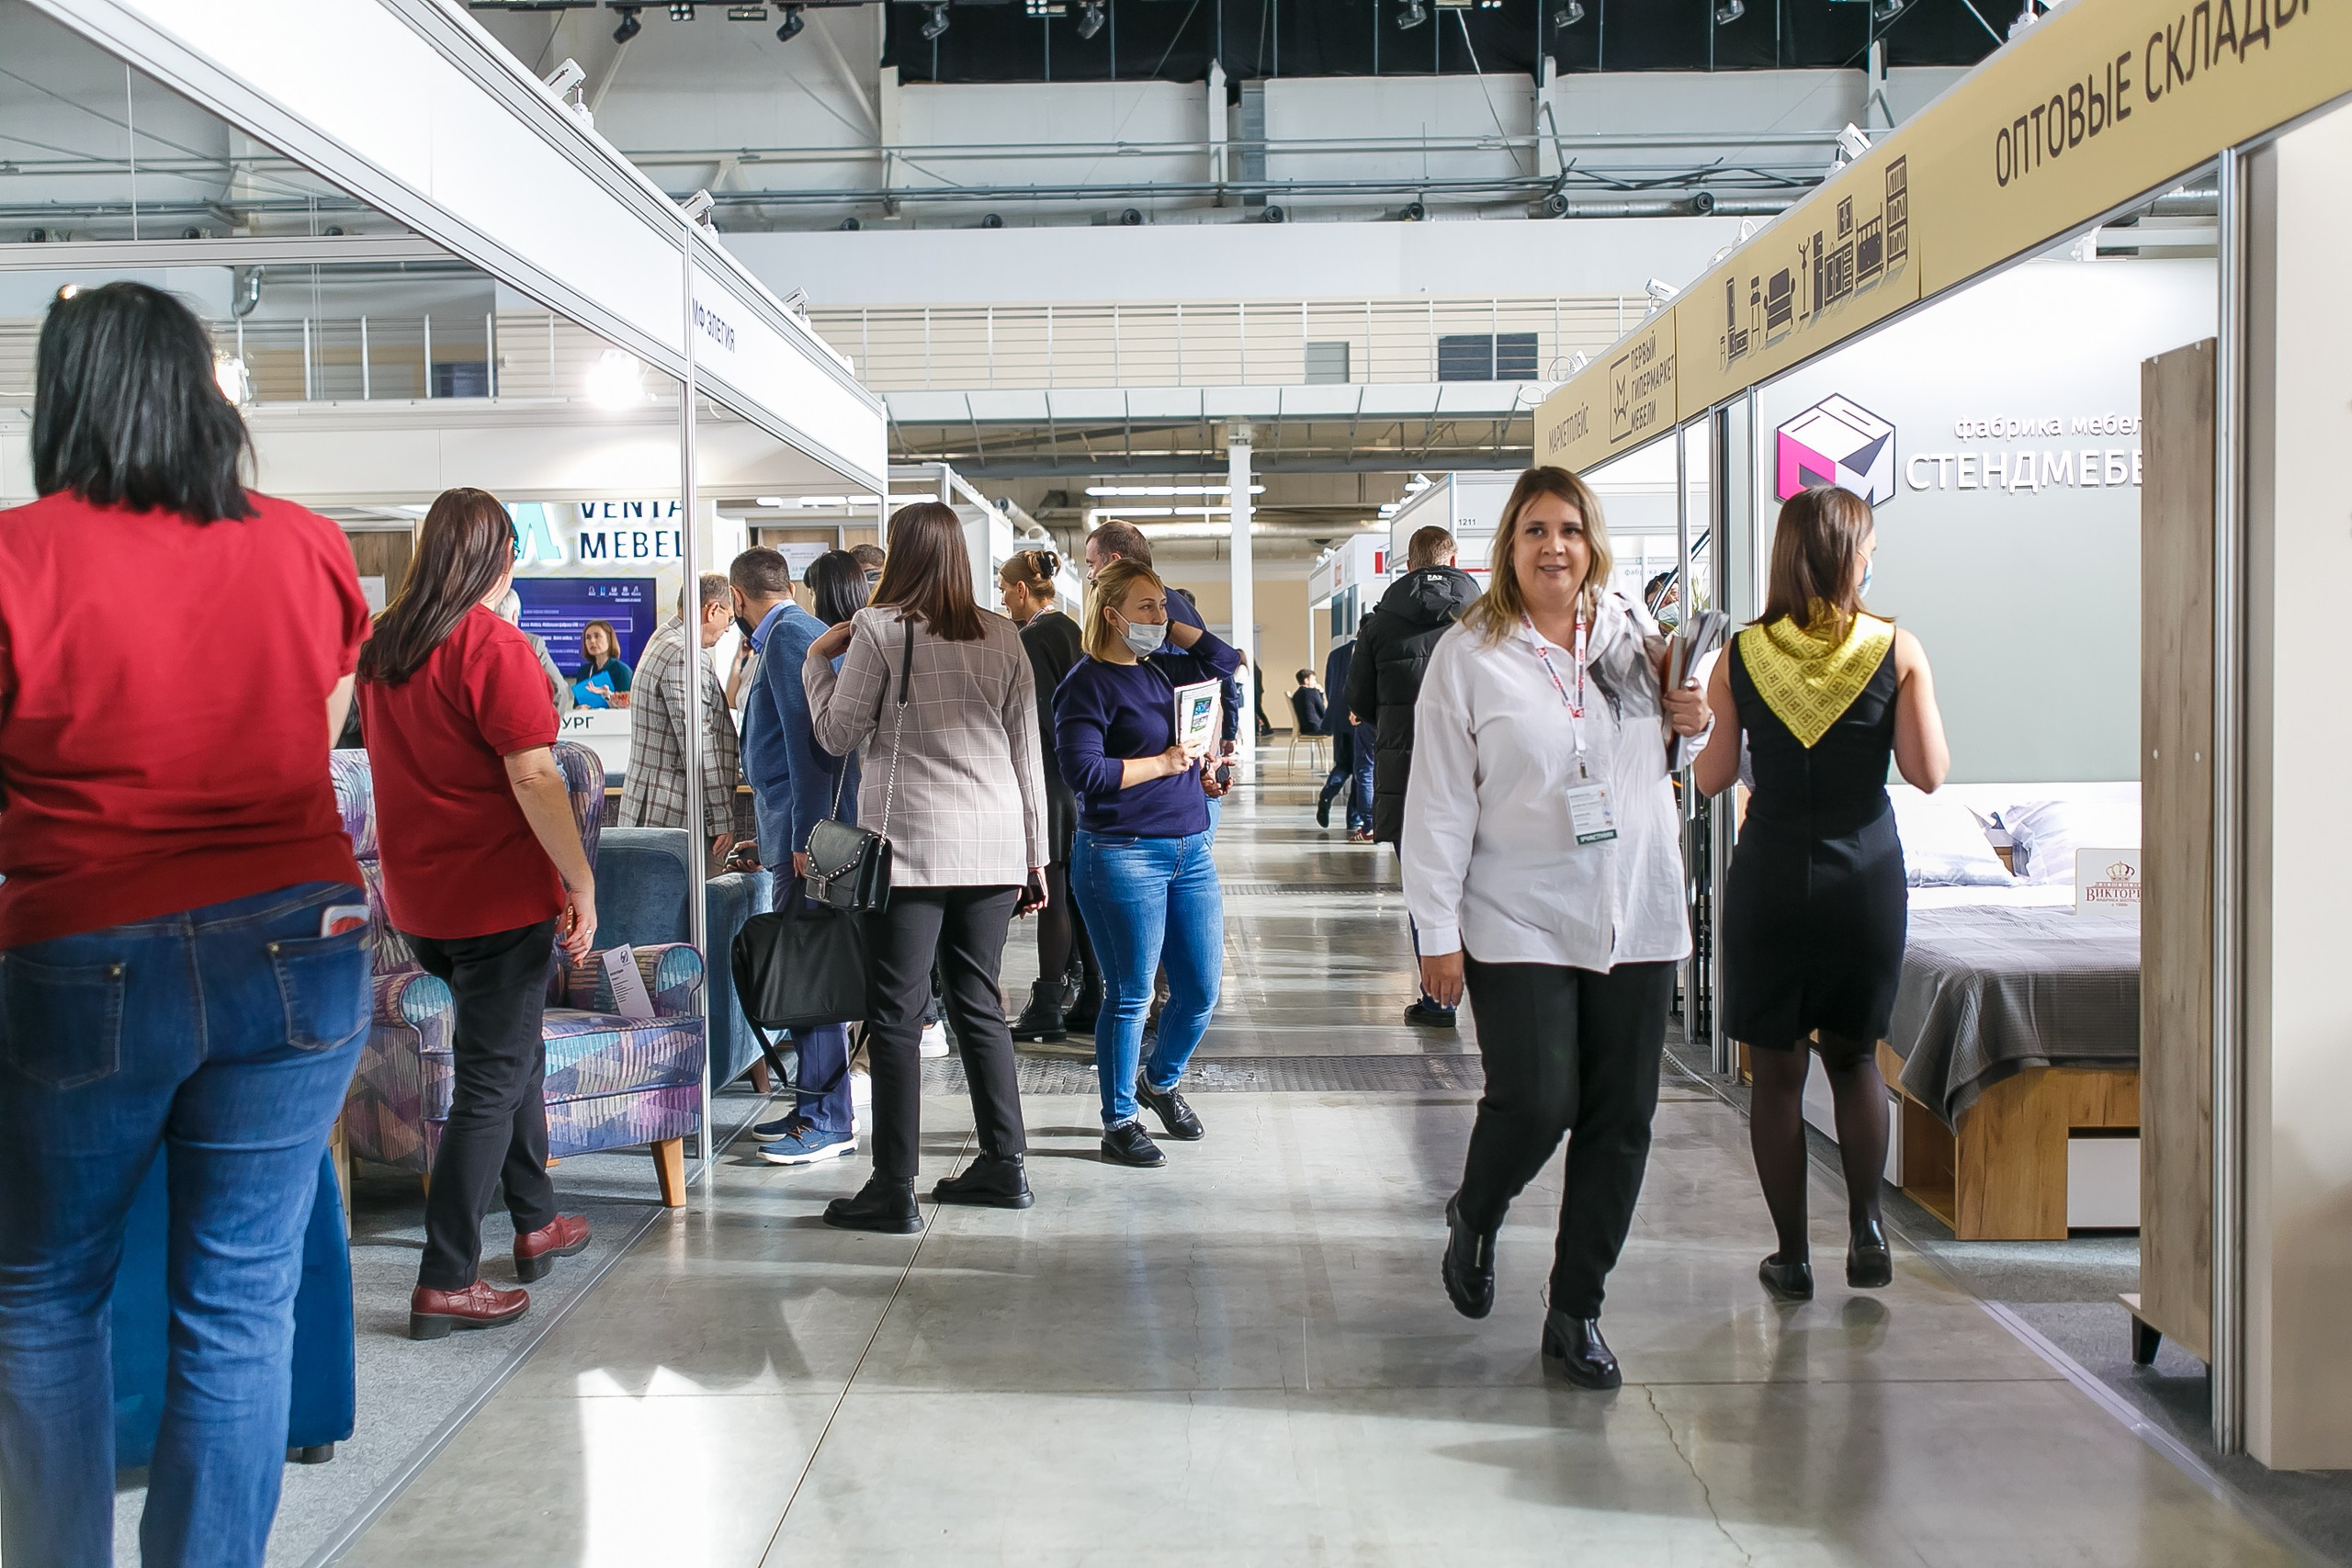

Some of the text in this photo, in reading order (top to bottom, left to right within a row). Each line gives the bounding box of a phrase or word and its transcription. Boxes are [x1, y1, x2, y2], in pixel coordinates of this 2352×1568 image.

[1996, 51, 2132, 187] ОПТОВЫЕ
[707, 310, 735, 353] ЭЛЕГИЯ
[1631, 329, 1656, 373] ПЕРВЫЙ
[1631, 354, 1674, 403] ГИПЕРМАРКЕТ
[1548, 401, 1589, 456] МАРКЕТПЛЕЙС
[1631, 399, 1656, 433] МЕБЕЛИ
[1954, 414, 2064, 442] фабрика
[1458, 518, 1476, 526] 1211
[581, 530, 684, 559] MEBEL
[562, 716, 594, 729] УРГ
